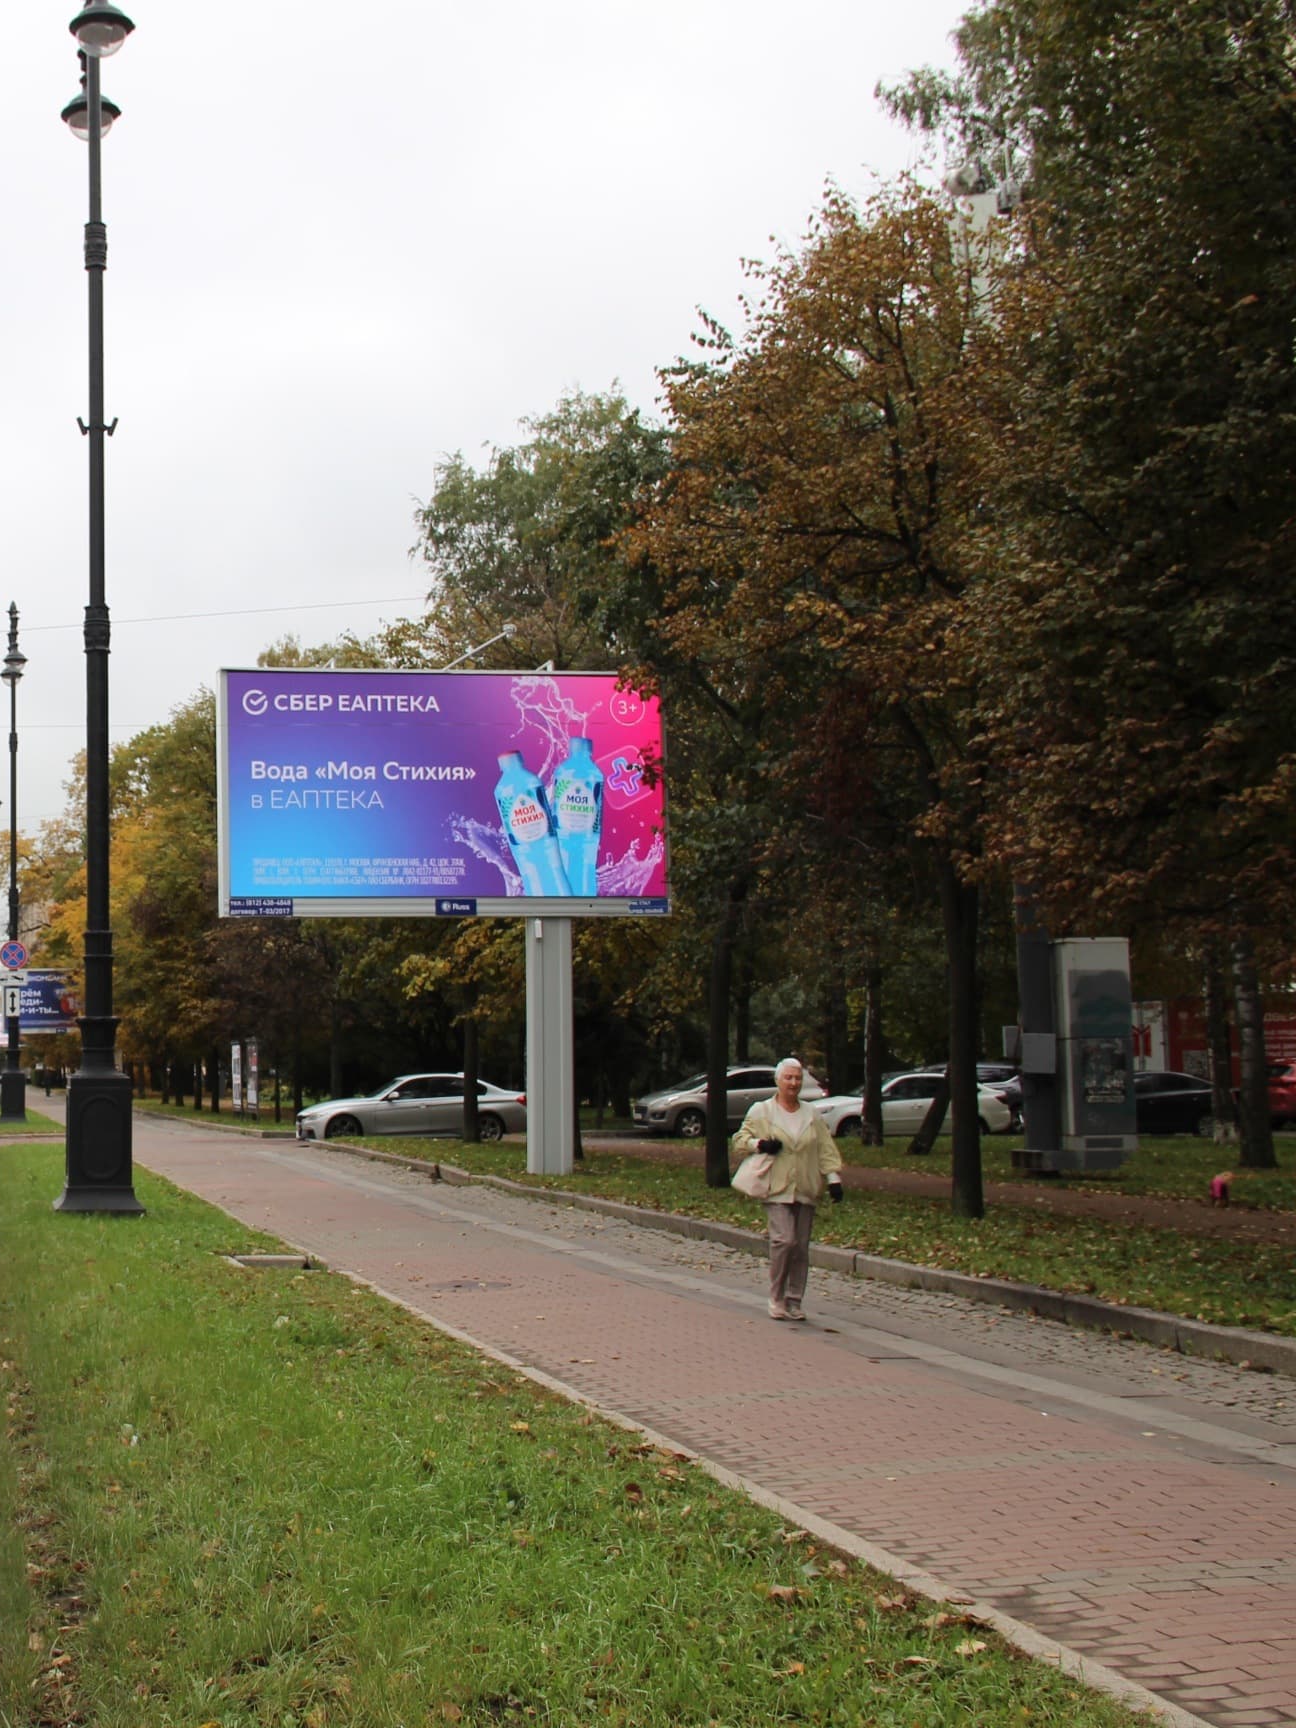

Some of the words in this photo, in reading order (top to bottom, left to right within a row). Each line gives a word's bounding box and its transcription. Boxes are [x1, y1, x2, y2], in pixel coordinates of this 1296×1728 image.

[274, 694, 333, 711] СБЕР
[338, 695, 440, 713] ЕАПТЕКА
[618, 700, 637, 715] 3+
[251, 761, 308, 782] Вода
[315, 761, 376, 780] «Моя
[383, 761, 476, 781] Стихия»
[251, 795, 263, 809] в
[270, 790, 384, 809] ЕАПТЕКА
[566, 795, 589, 804] МОЯ
[514, 804, 536, 817] МОЯ
[559, 803, 594, 814] СТИХИЯ
[511, 812, 545, 827] СТИХИЯ
